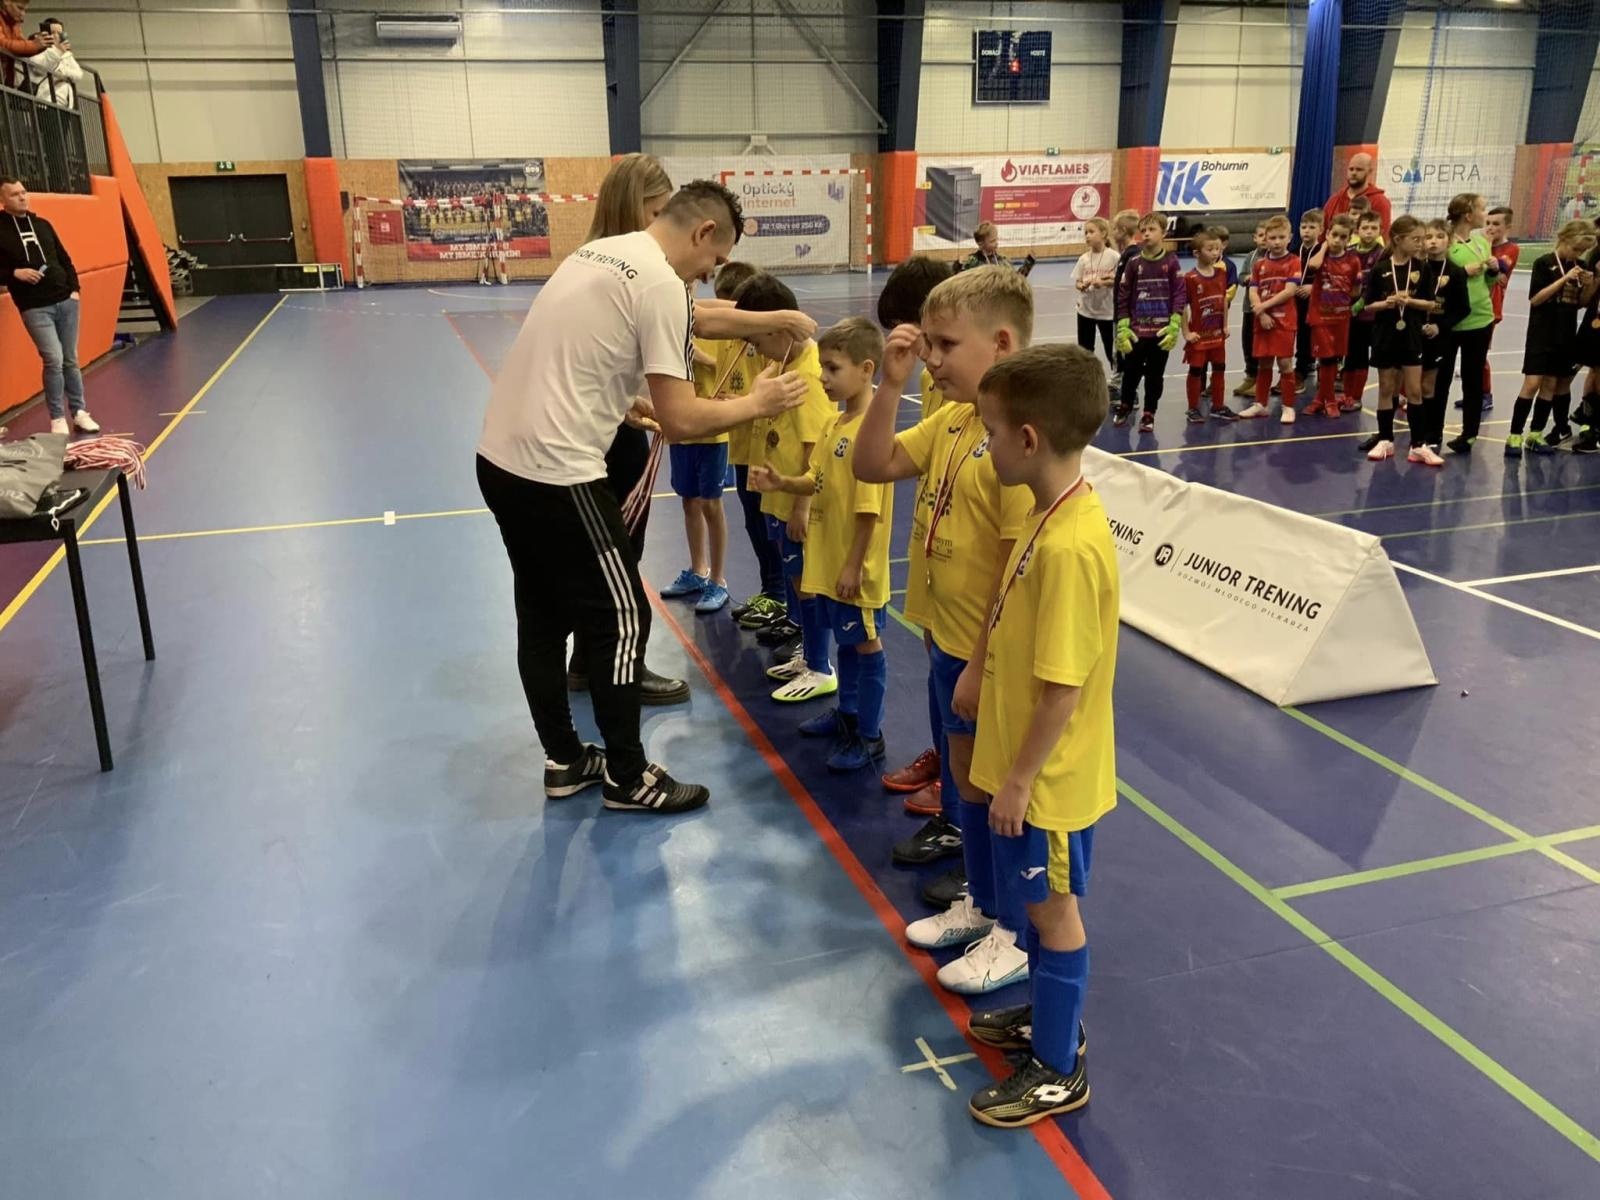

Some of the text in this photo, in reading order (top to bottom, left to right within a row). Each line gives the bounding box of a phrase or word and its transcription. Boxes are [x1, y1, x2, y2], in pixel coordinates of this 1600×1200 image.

[1018, 163, 1090, 176] VIAFLAMES
[742, 182, 795, 197] Optický
[592, 253, 638, 280] TRENING
[1183, 552, 1322, 620] JUNIOR TRENING
